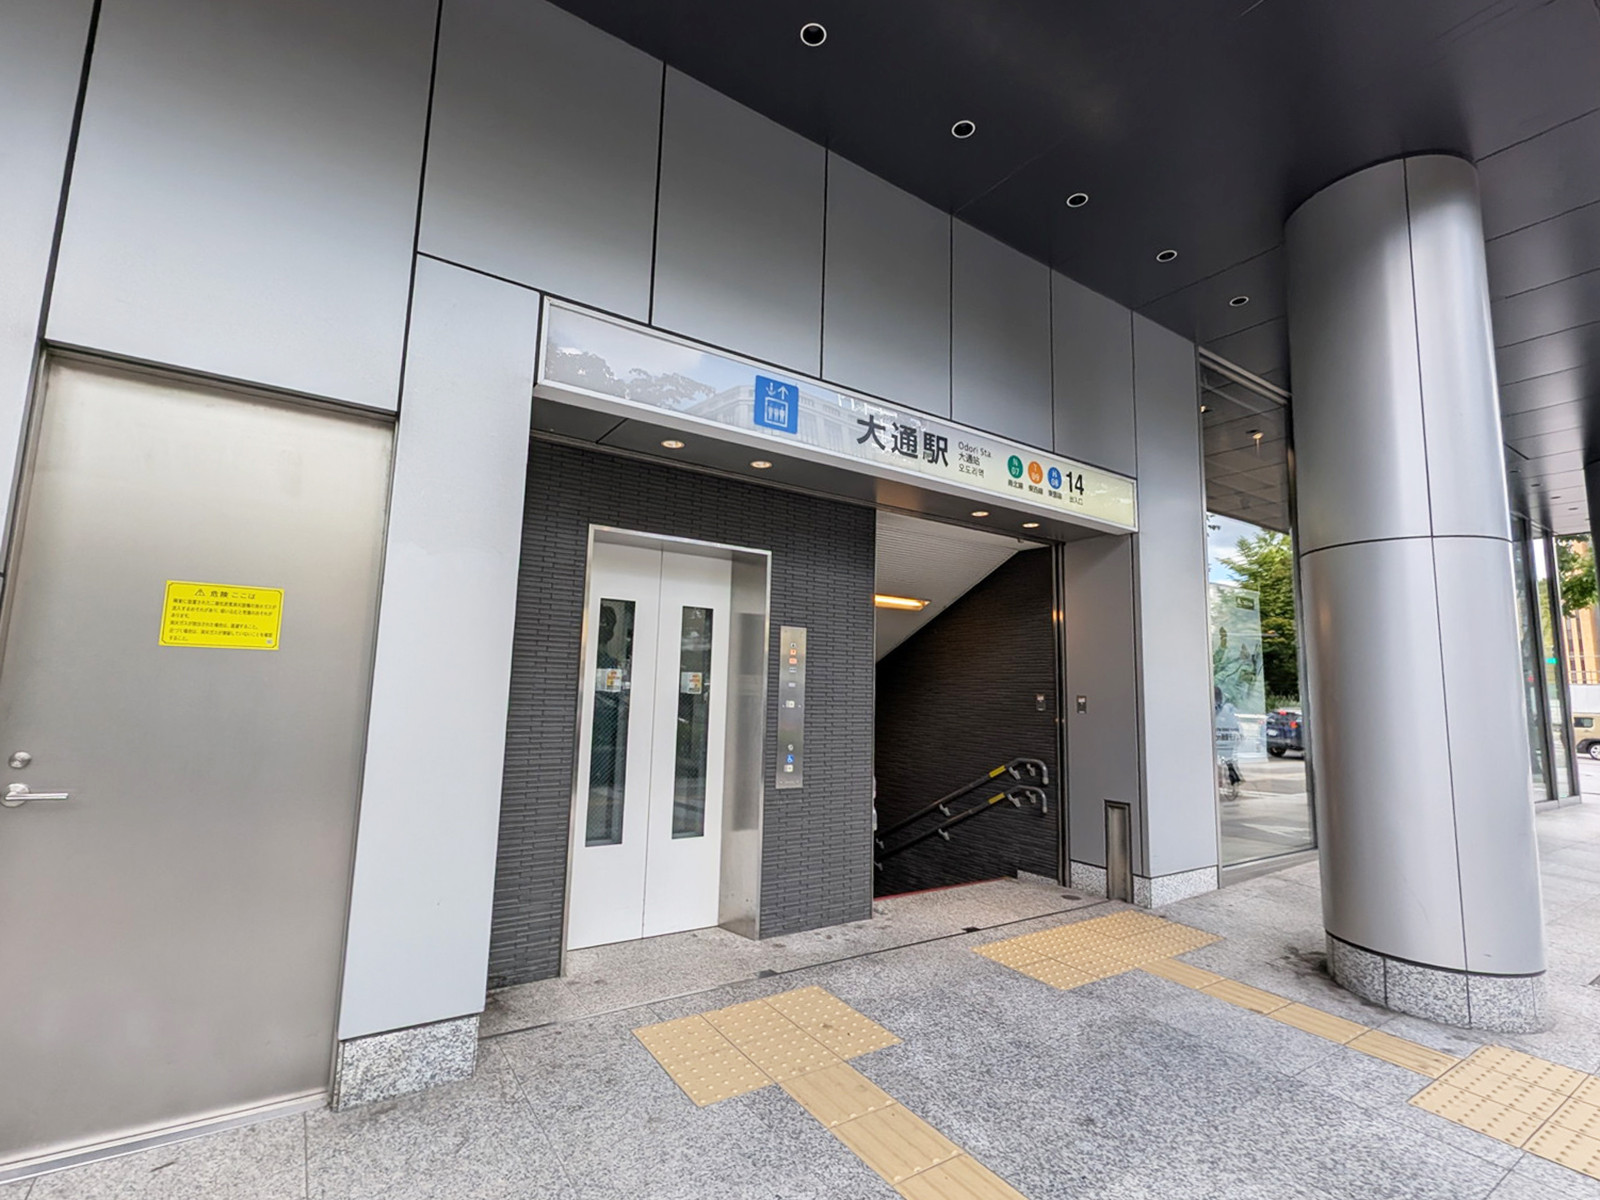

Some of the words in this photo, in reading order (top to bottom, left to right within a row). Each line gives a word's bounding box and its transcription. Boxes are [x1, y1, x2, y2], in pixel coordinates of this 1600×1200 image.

[857, 414, 949, 467] 大通駅
[958, 441, 979, 453] Odori
[958, 463, 985, 478] 오도리역
[1066, 471, 1085, 496] 14
